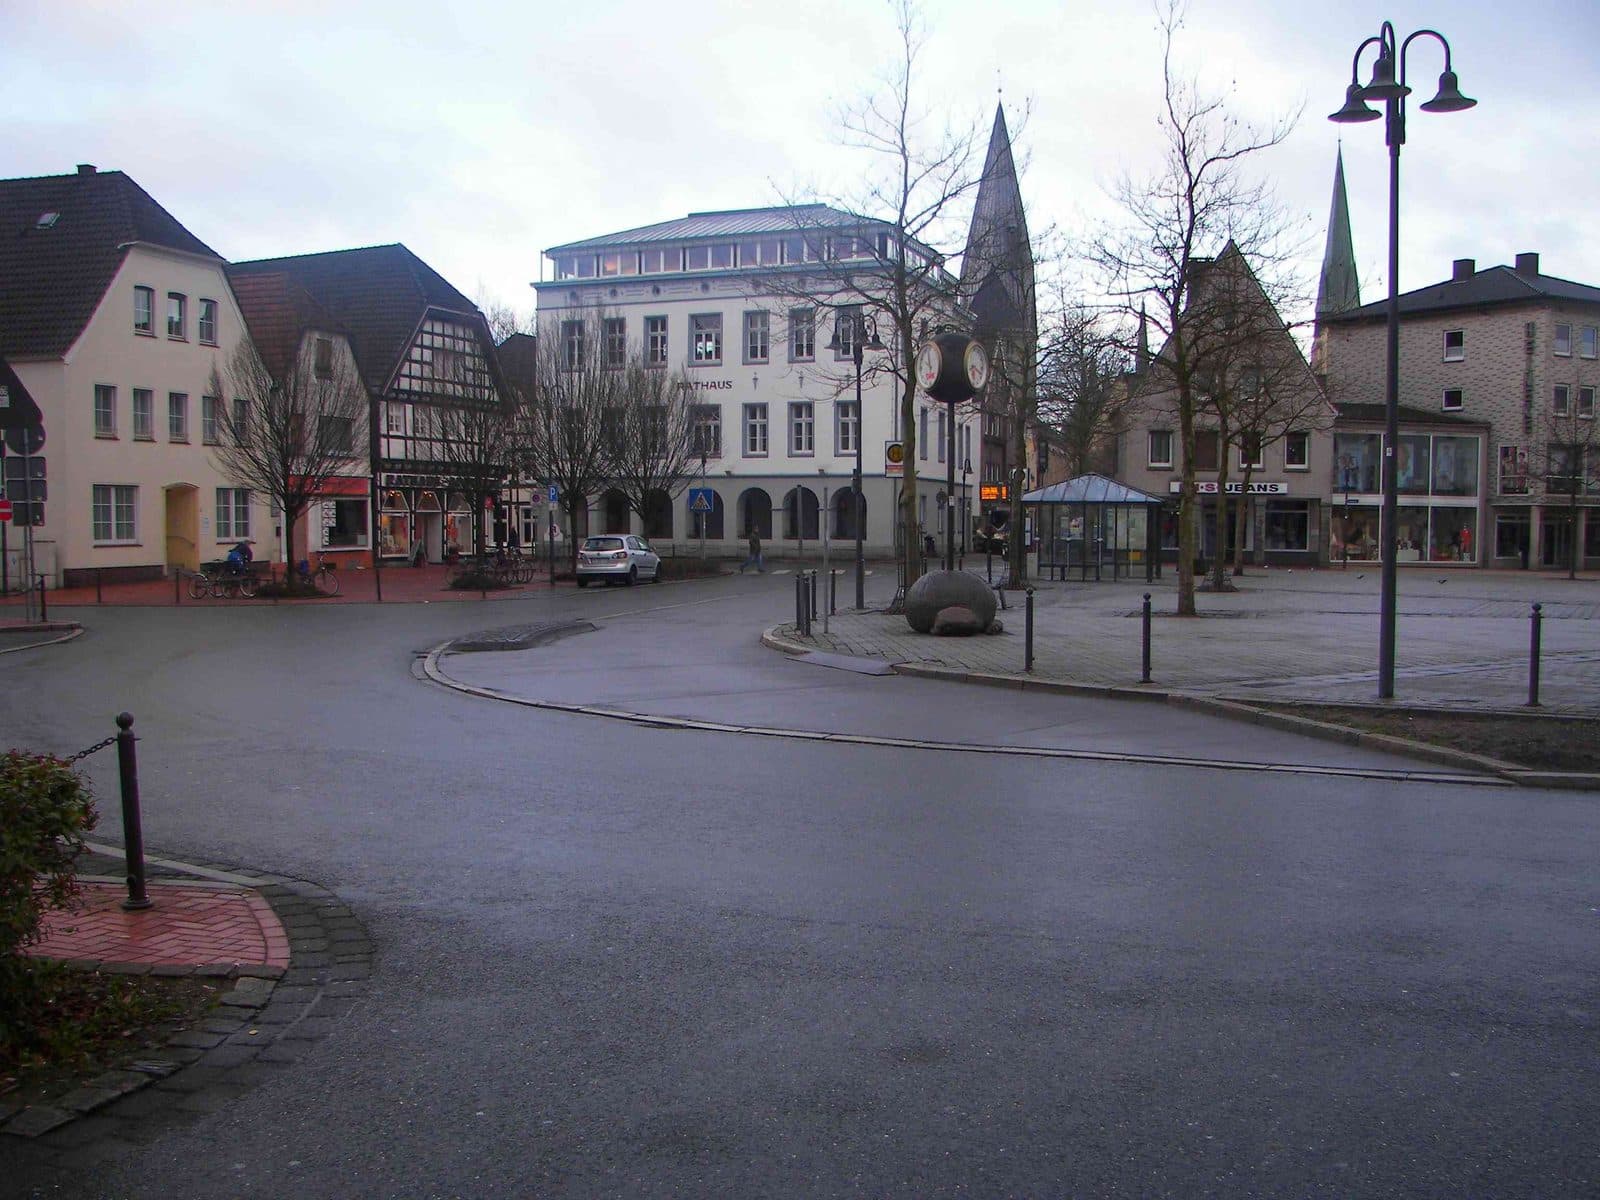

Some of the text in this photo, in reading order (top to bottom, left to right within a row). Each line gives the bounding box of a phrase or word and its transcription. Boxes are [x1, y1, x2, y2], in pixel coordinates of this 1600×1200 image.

[677, 380, 733, 391] RATHAUS
[550, 487, 556, 500] P
[1225, 483, 1279, 493] JEANS
